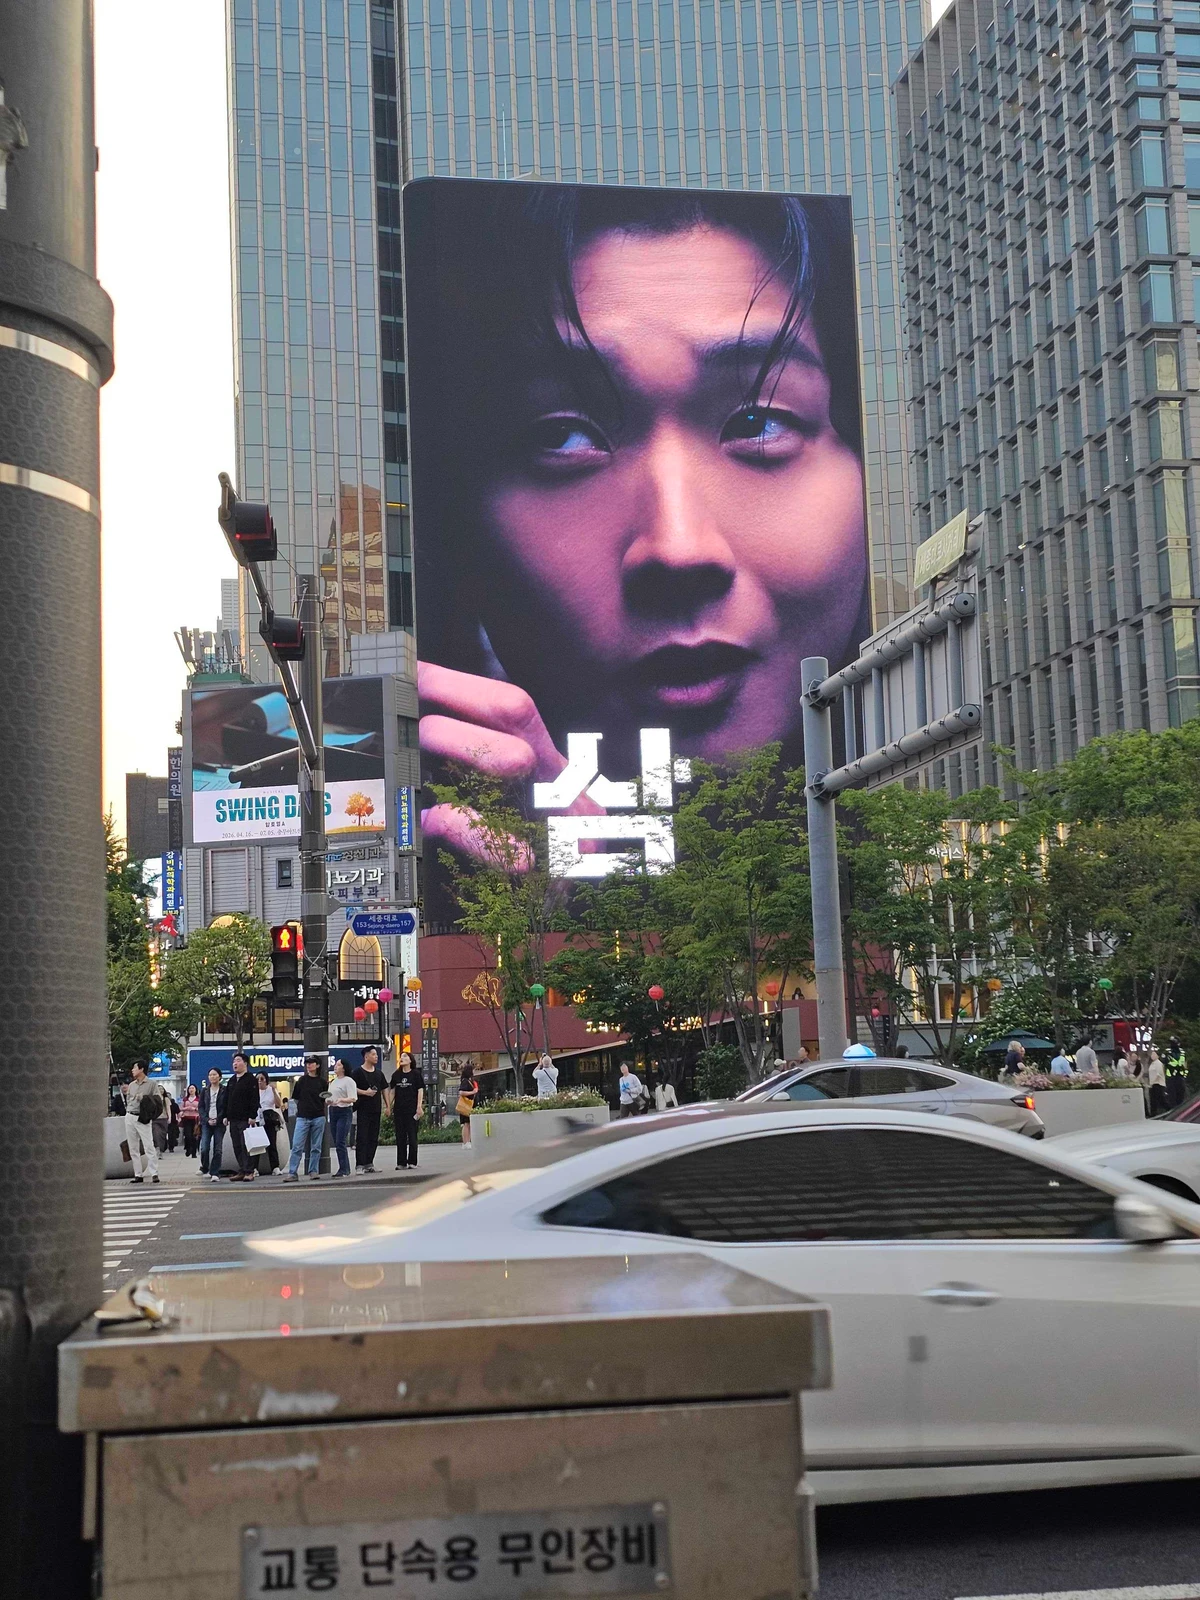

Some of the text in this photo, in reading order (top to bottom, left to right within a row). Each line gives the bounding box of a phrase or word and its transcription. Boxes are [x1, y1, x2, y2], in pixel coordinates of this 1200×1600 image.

[170, 757, 182, 797] 한의원
[216, 792, 332, 823] SWING DS
[338, 886, 379, 899] 피부과
[369, 914, 398, 922] 세종대로
[250, 1054, 304, 1070] umBurger
[260, 1522, 658, 1592] 교통 단속용 무인장비
